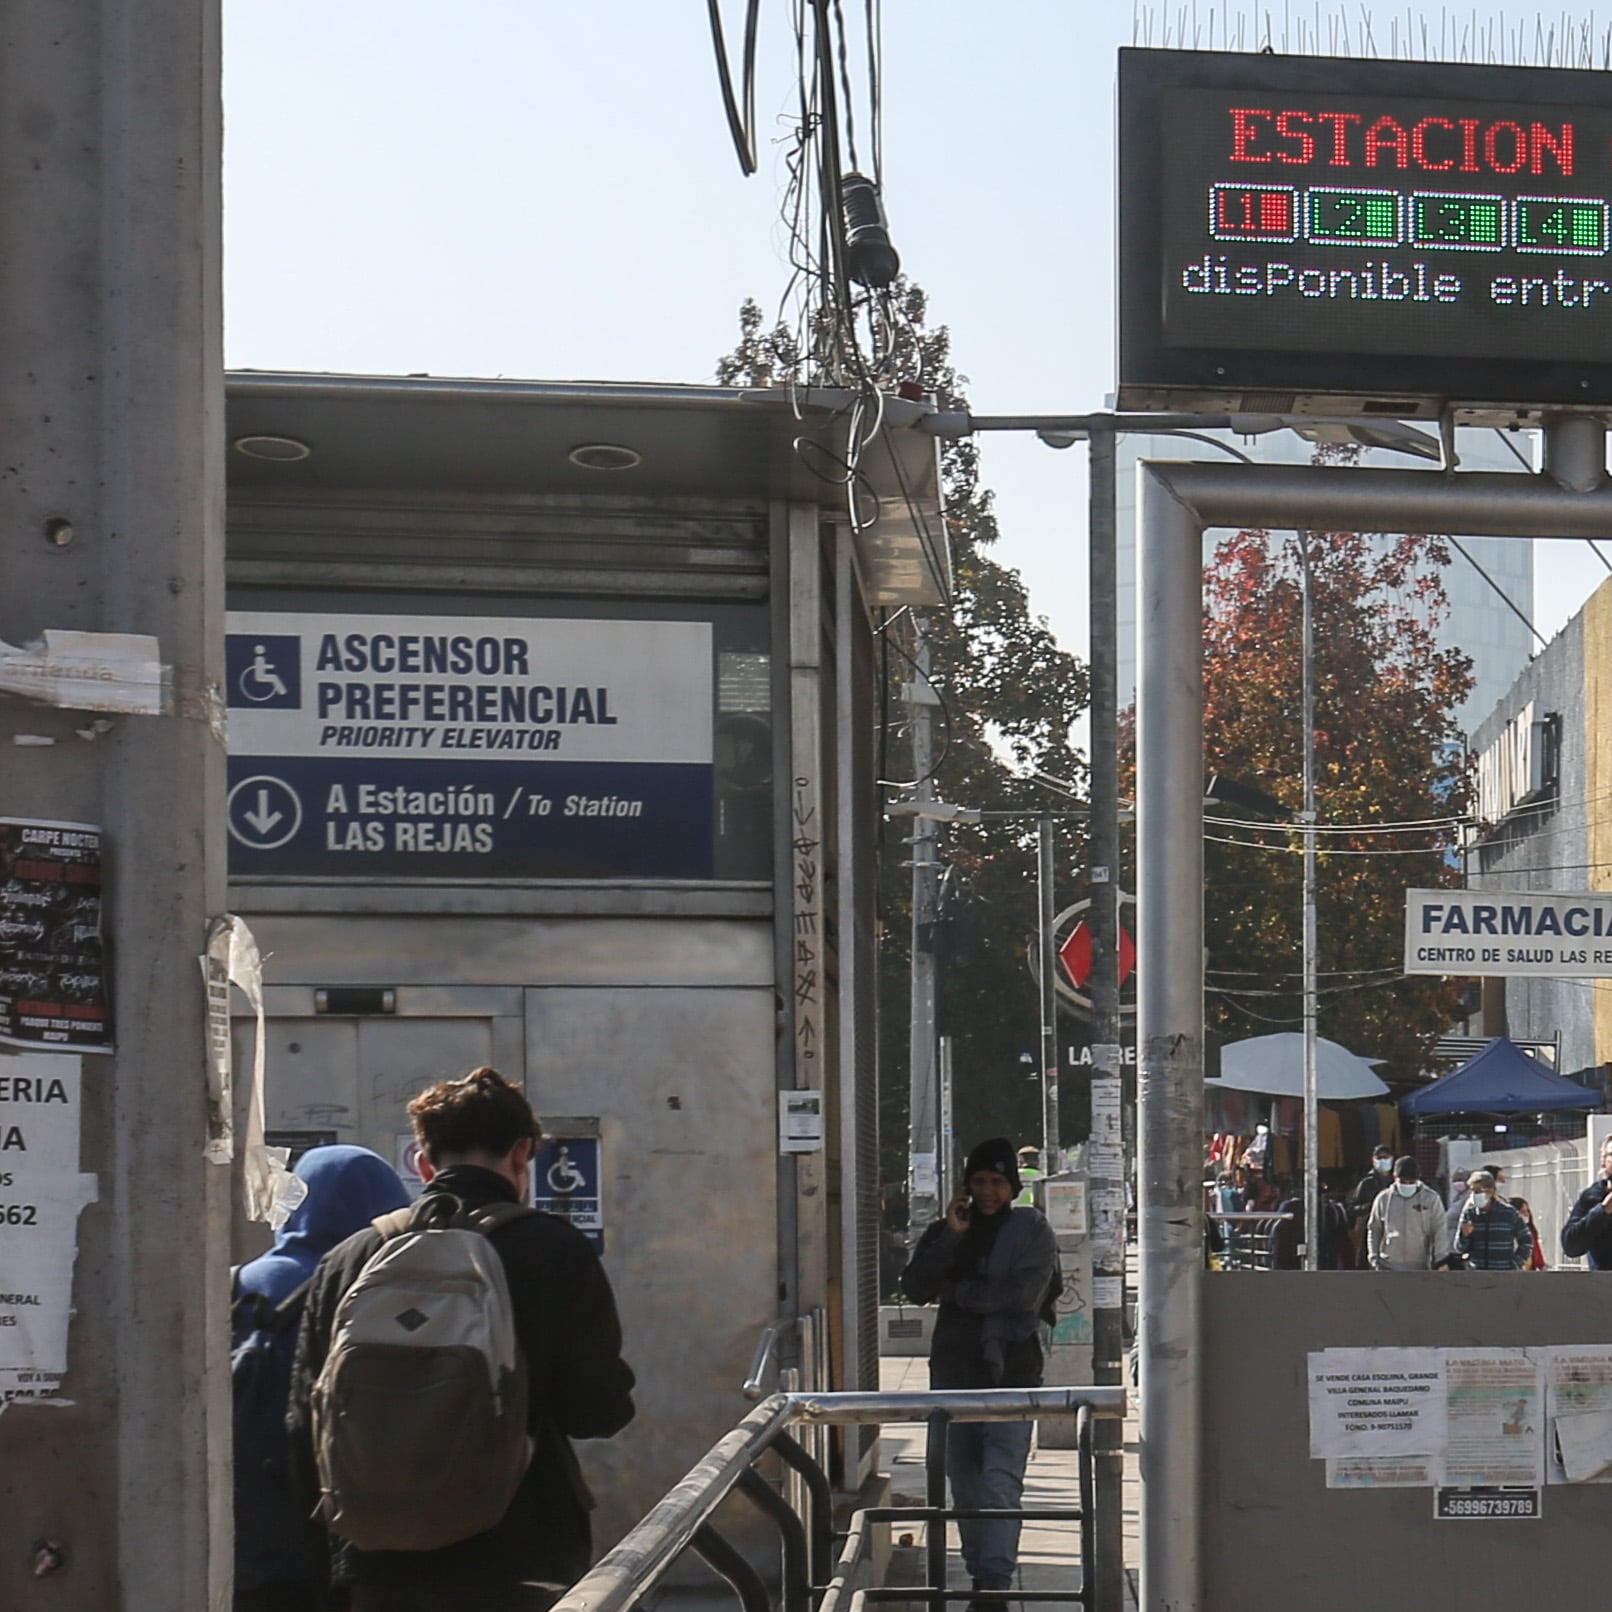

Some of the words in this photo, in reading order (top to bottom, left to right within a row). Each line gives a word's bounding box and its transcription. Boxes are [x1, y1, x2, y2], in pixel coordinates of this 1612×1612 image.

[1228, 107, 1575, 177] ESTACION
[1181, 255, 1463, 303] disponible
[316, 633, 530, 677] ASCENSOR
[317, 681, 618, 725] PREFERENCIAL
[319, 725, 433, 749] PRIORITY
[439, 727, 562, 752] ELEVATOR
[326, 785, 348, 815] A
[358, 784, 496, 818] Estación
[527, 793, 552, 816] To
[563, 794, 643, 818] Station
[326, 821, 384, 853] LAS
[394, 822, 494, 854] REJAS
[1417, 947, 1475, 962] CENTRO
[1481, 948, 1501, 962] DE
[1507, 948, 1554, 964] SALUD
[1560, 950, 1588, 964] LAS
